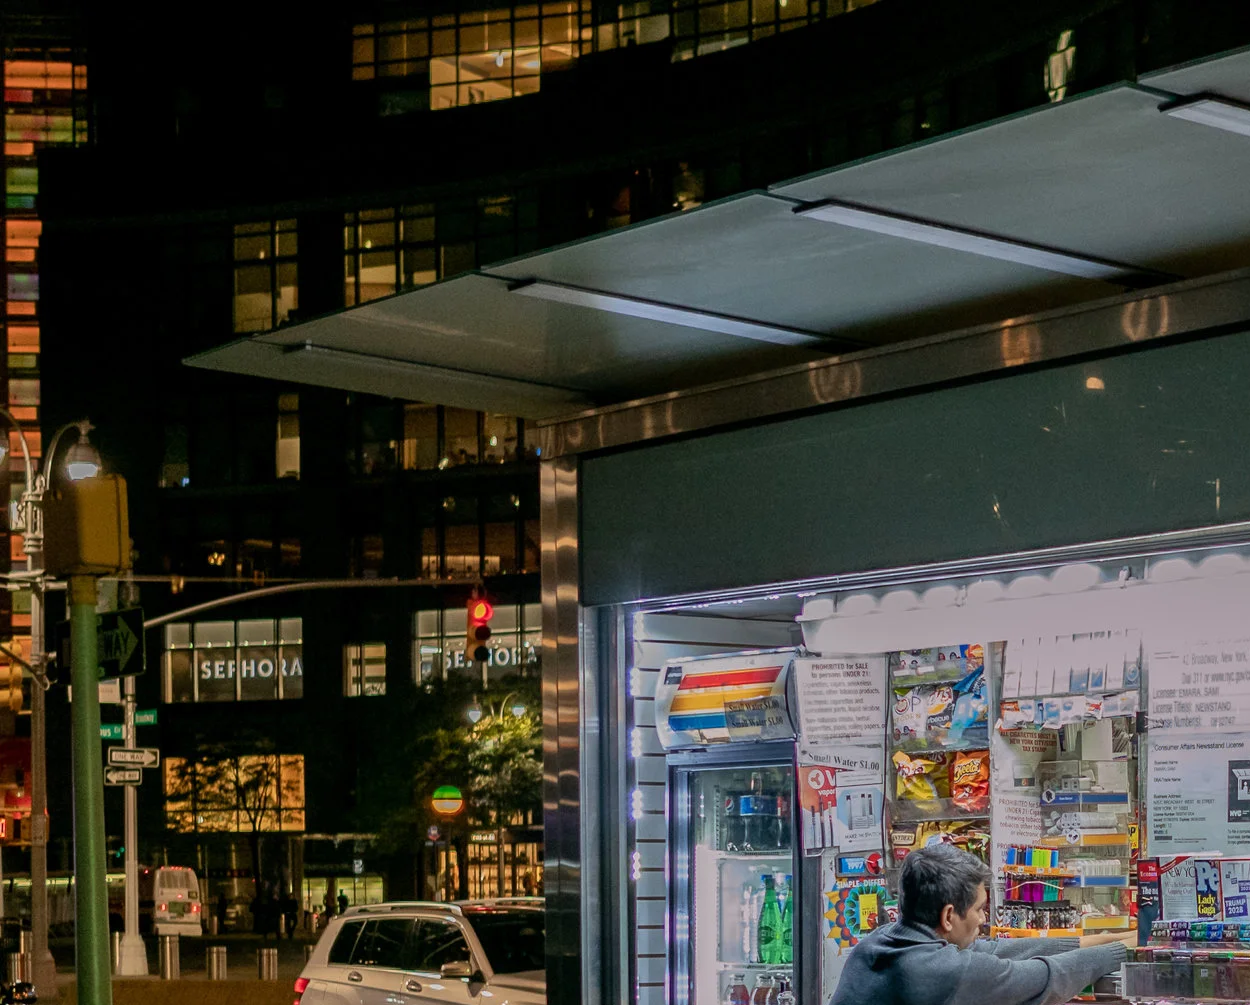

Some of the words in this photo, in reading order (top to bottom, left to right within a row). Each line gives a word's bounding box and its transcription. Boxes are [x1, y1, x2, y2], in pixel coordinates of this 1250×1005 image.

[1221, 652, 1233, 663] New
[201, 657, 302, 680] SEPHORA
[834, 756, 858, 768] Water
[860, 760, 880, 771] $1.00
[999, 798, 1028, 807] PROHIBITED
[1198, 894, 1216, 904] Lady
[1225, 899, 1246, 907] TRUMP
[1198, 905, 1216, 915] Gaga
